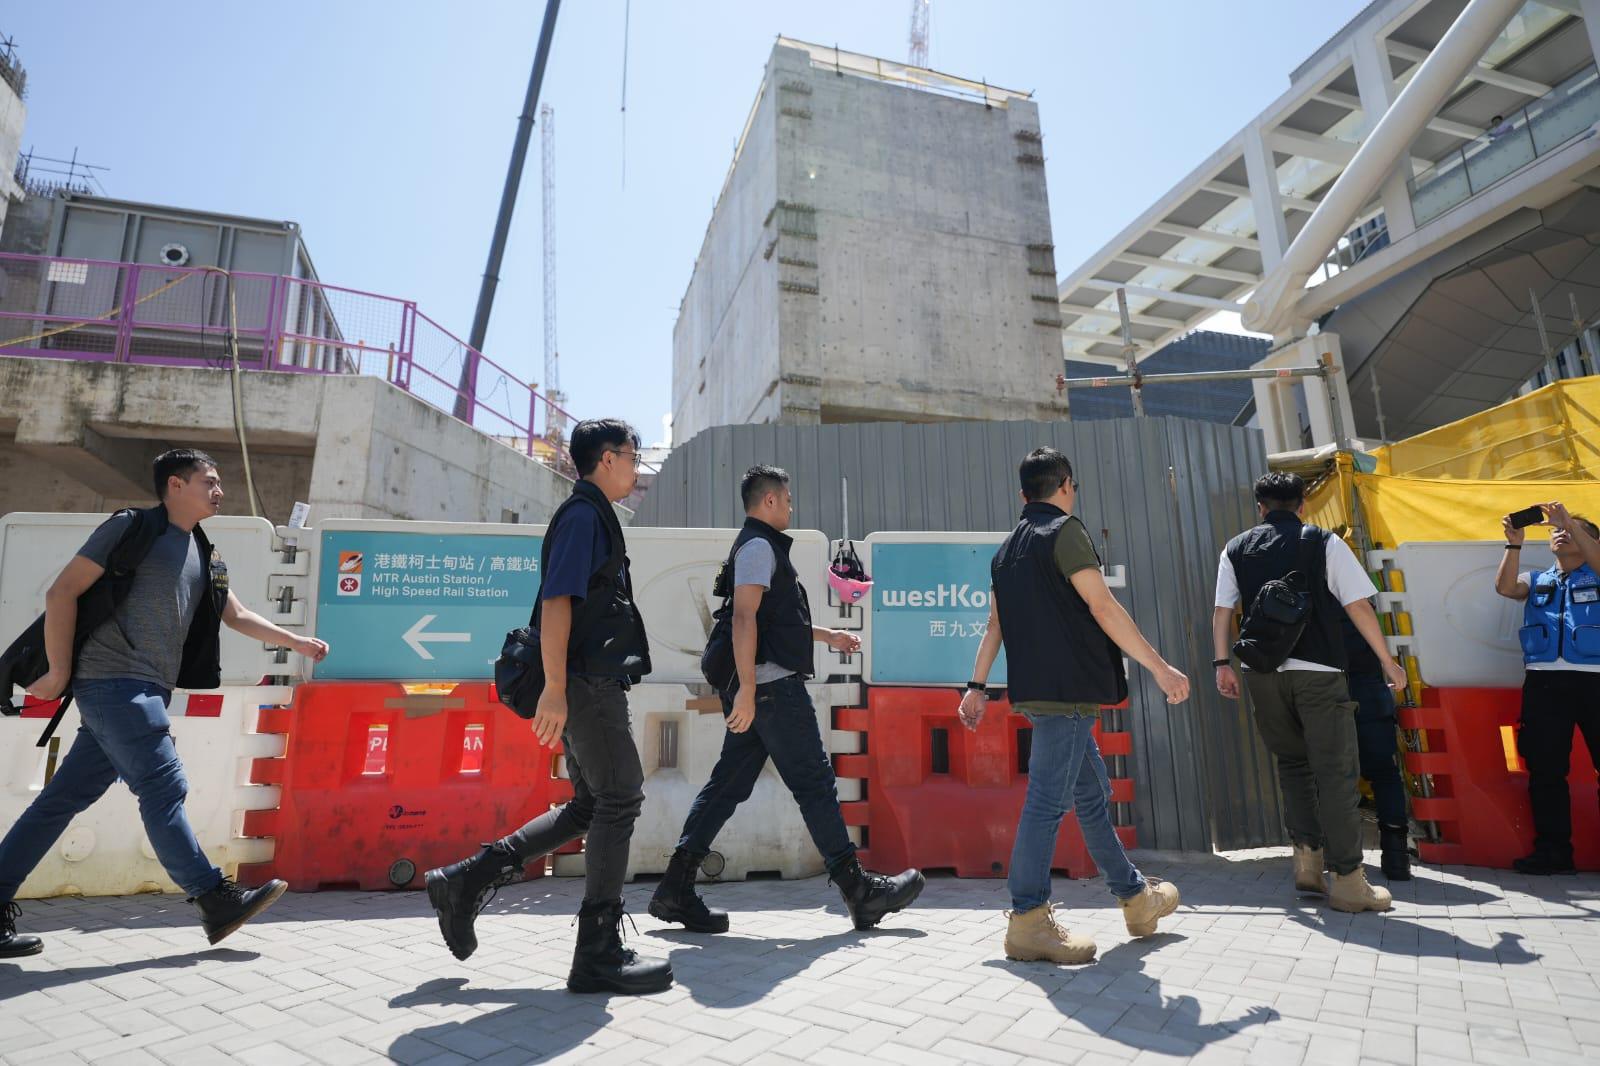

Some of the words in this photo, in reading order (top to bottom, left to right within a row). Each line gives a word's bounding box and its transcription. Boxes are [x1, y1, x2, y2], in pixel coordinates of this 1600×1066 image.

[374, 553, 475, 570] 港鐵柯士甸站
[478, 557, 485, 573] /
[490, 556, 539, 572] 高鐵站
[372, 573, 400, 583] MTR
[402, 573, 440, 584] Austin
[443, 574, 484, 585] Station
[487, 575, 492, 585] /
[372, 586, 399, 598] High
[402, 586, 440, 598] Speed
[443, 586, 464, 597] Rail
[467, 587, 509, 597] Station
[882, 584, 992, 608] westKo
